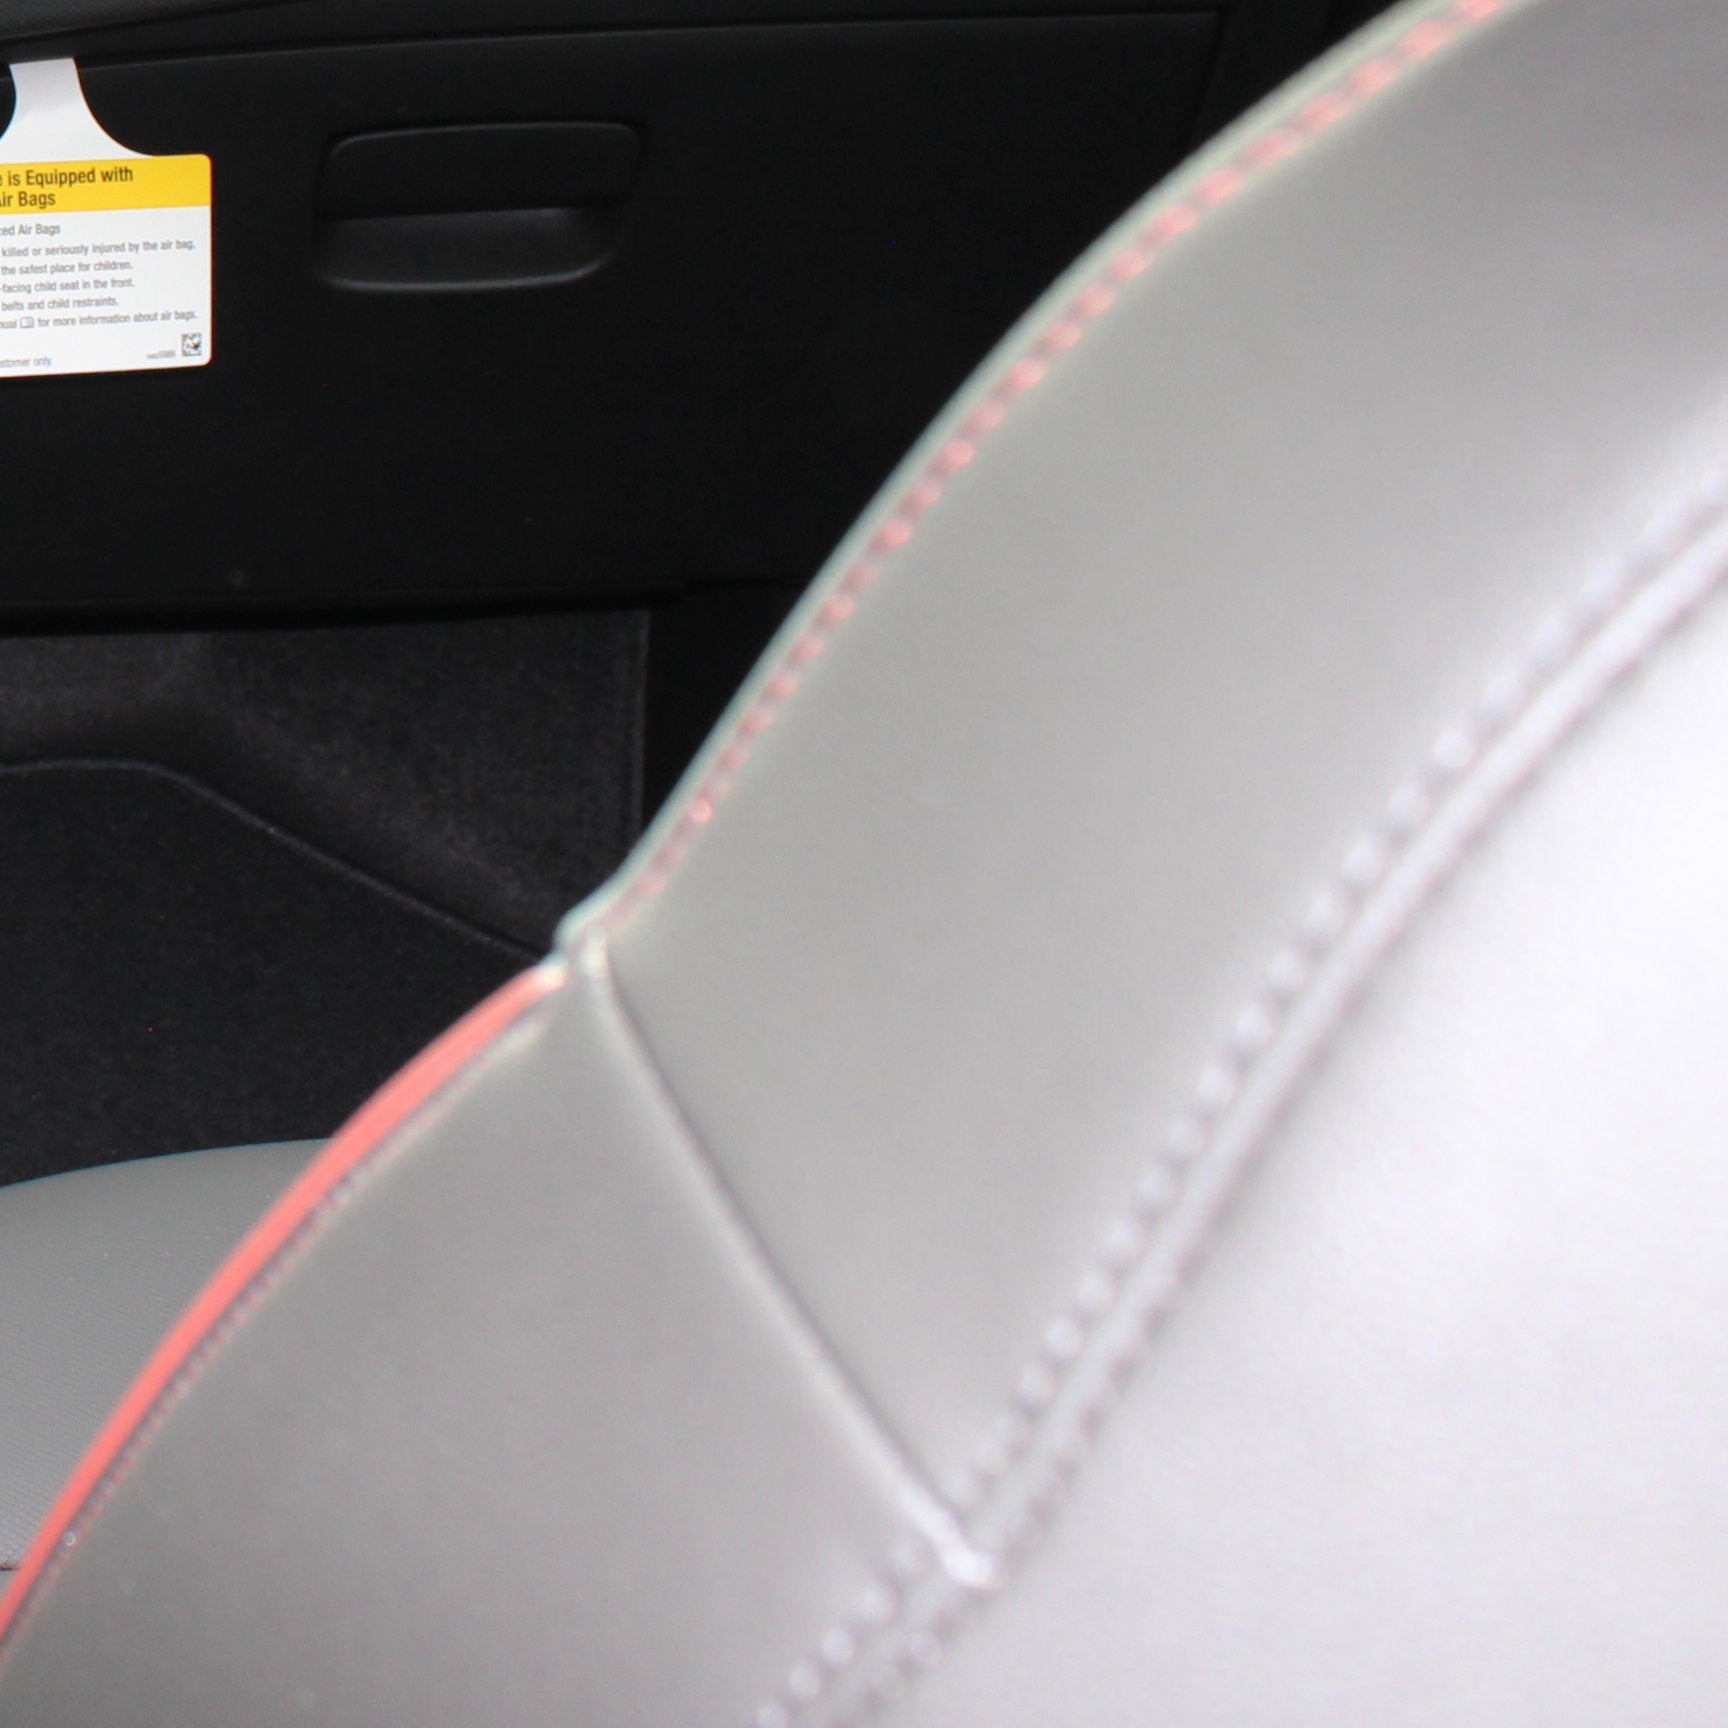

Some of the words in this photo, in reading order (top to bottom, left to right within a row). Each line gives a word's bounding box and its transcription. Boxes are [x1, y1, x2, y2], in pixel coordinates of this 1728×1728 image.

[8, 170, 21, 186] is
[26, 169, 96, 187] Equipped
[101, 166, 133, 182] with
[18, 191, 56, 209] Bags
[18, 224, 32, 235] Air
[35, 223, 61, 237] Bags
[2, 246, 29, 257] killed
[32, 247, 42, 256] or
[45, 244, 89, 256] seriously
[92, 243, 125, 255] injured
[128, 242, 140, 253] by
[143, 241, 158, 251] the
[160, 240, 173, 250] air
[175, 239, 196, 251] bag.
[1, 266, 16, 276] the
[19, 264, 48, 274] safest
[50, 263, 75, 275] place
[78, 262, 91, 272] for
[94, 260, 133, 271] children.
[34, 281, 57, 292] child
[60, 280, 79, 291] seat
[82, 280, 91, 290] in
[94, 278, 108, 289] the
[111, 278, 135, 288] front.
[1, 301, 24, 311] belts
[27, 300, 45, 309] and
[47, 298, 70, 309] child
[72, 296, 119, 308] restraints.
[38, 318, 50, 327] for
[53, 317, 76, 326] more
[79, 314, 131, 325] information
[133, 312, 158, 323] about
[160, 310, 173, 320] air
[175, 310, 197, 321] bags.
[33, 356, 54, 368] only.
